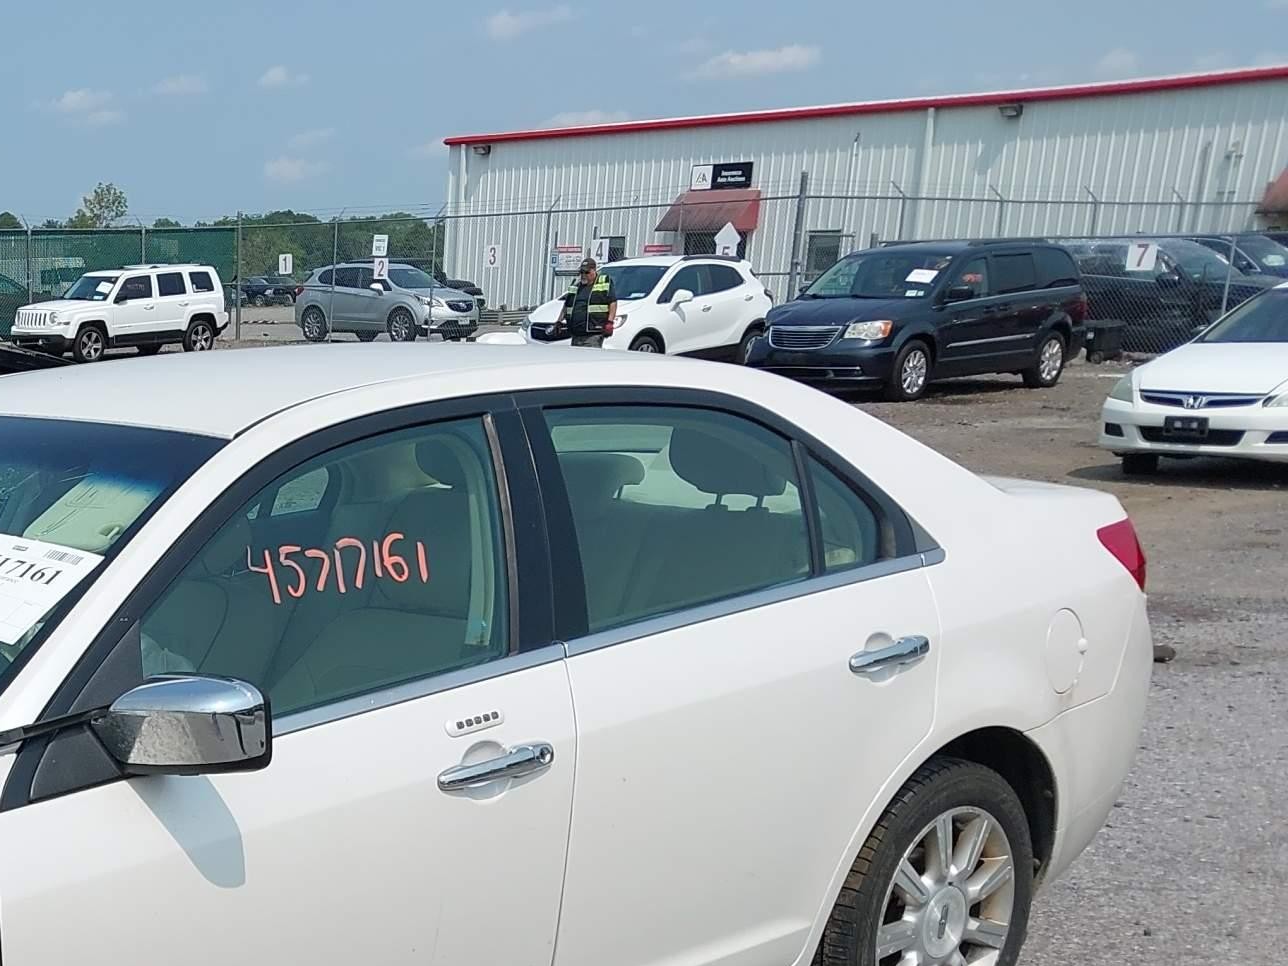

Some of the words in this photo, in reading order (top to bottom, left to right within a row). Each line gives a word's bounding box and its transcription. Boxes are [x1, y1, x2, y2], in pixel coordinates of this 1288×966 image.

[488, 246, 497, 266] 3
[596, 241, 603, 259] 4
[1137, 243, 1150, 268] 7
[281, 256, 288, 273] 1
[377, 260, 385, 277] 2
[247, 532, 429, 604] 45717161
